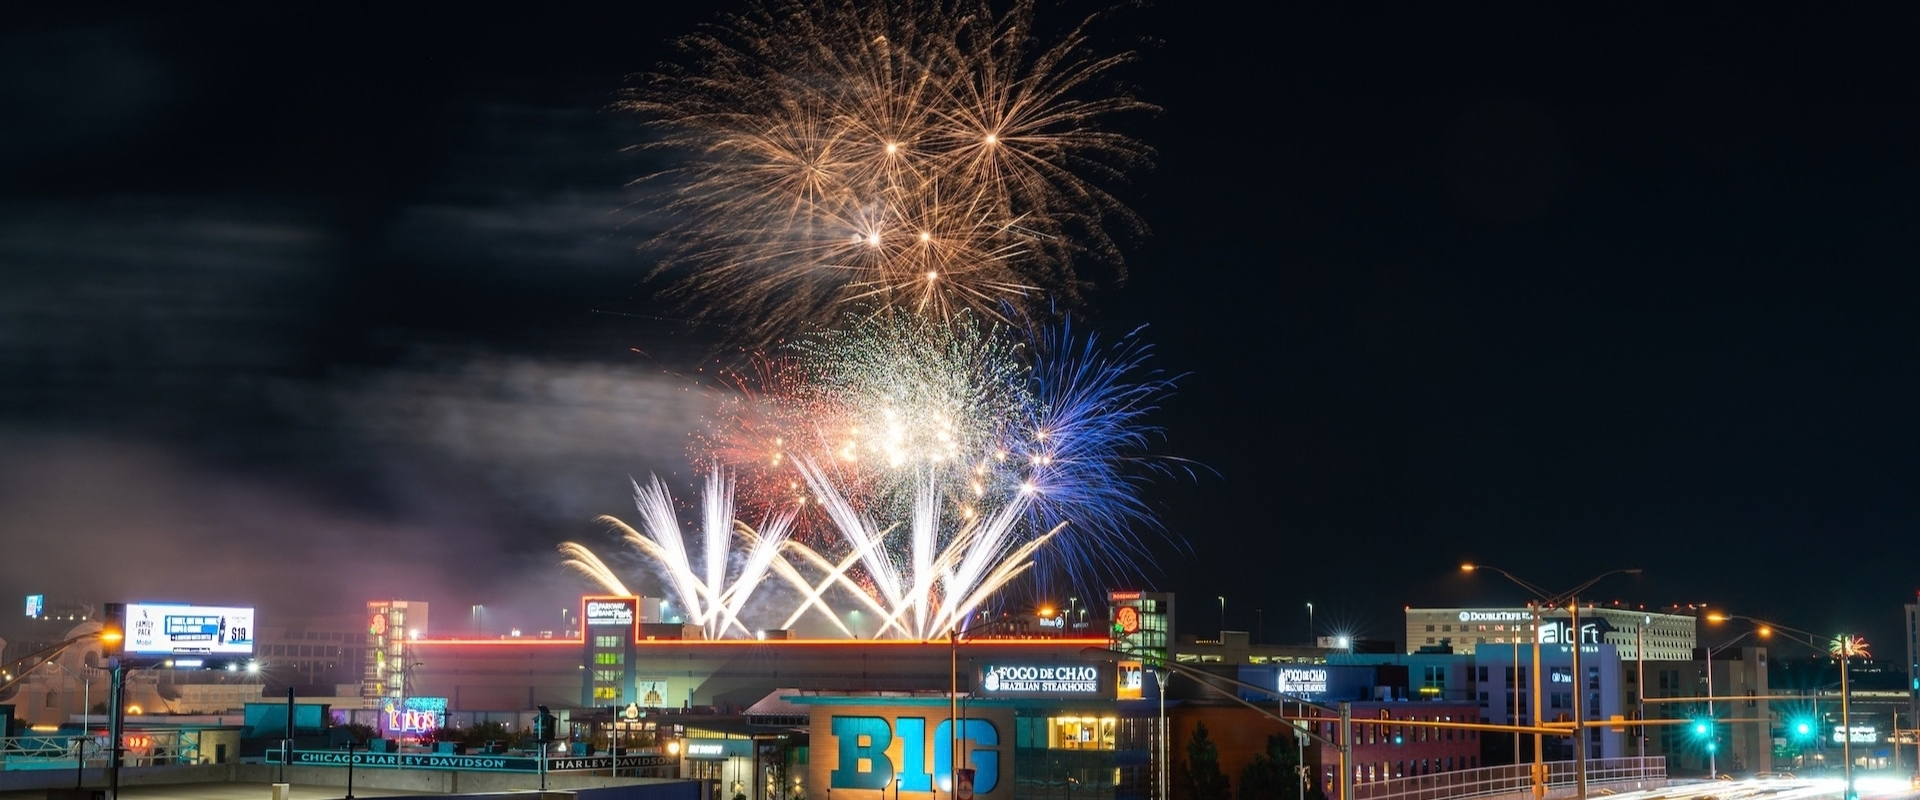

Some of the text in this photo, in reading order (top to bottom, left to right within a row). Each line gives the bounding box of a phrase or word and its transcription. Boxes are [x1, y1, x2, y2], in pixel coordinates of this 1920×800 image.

[598, 602, 625, 610] PARKWAY
[135, 620, 154, 629] FAMILY
[137, 628, 151, 637] PACK
[231, 626, 246, 641] $19
[1000, 666, 1039, 680] FOGO
[1040, 668, 1054, 680] DE
[1000, 682, 1097, 692] BRAZILIAN STEAKHOUSE
[390, 710, 434, 733] KINGS
[301, 753, 503, 768] CHICAGO HARLEY-DAVIDSON
[555, 757, 675, 769] HARLEY-DAVIDSON
